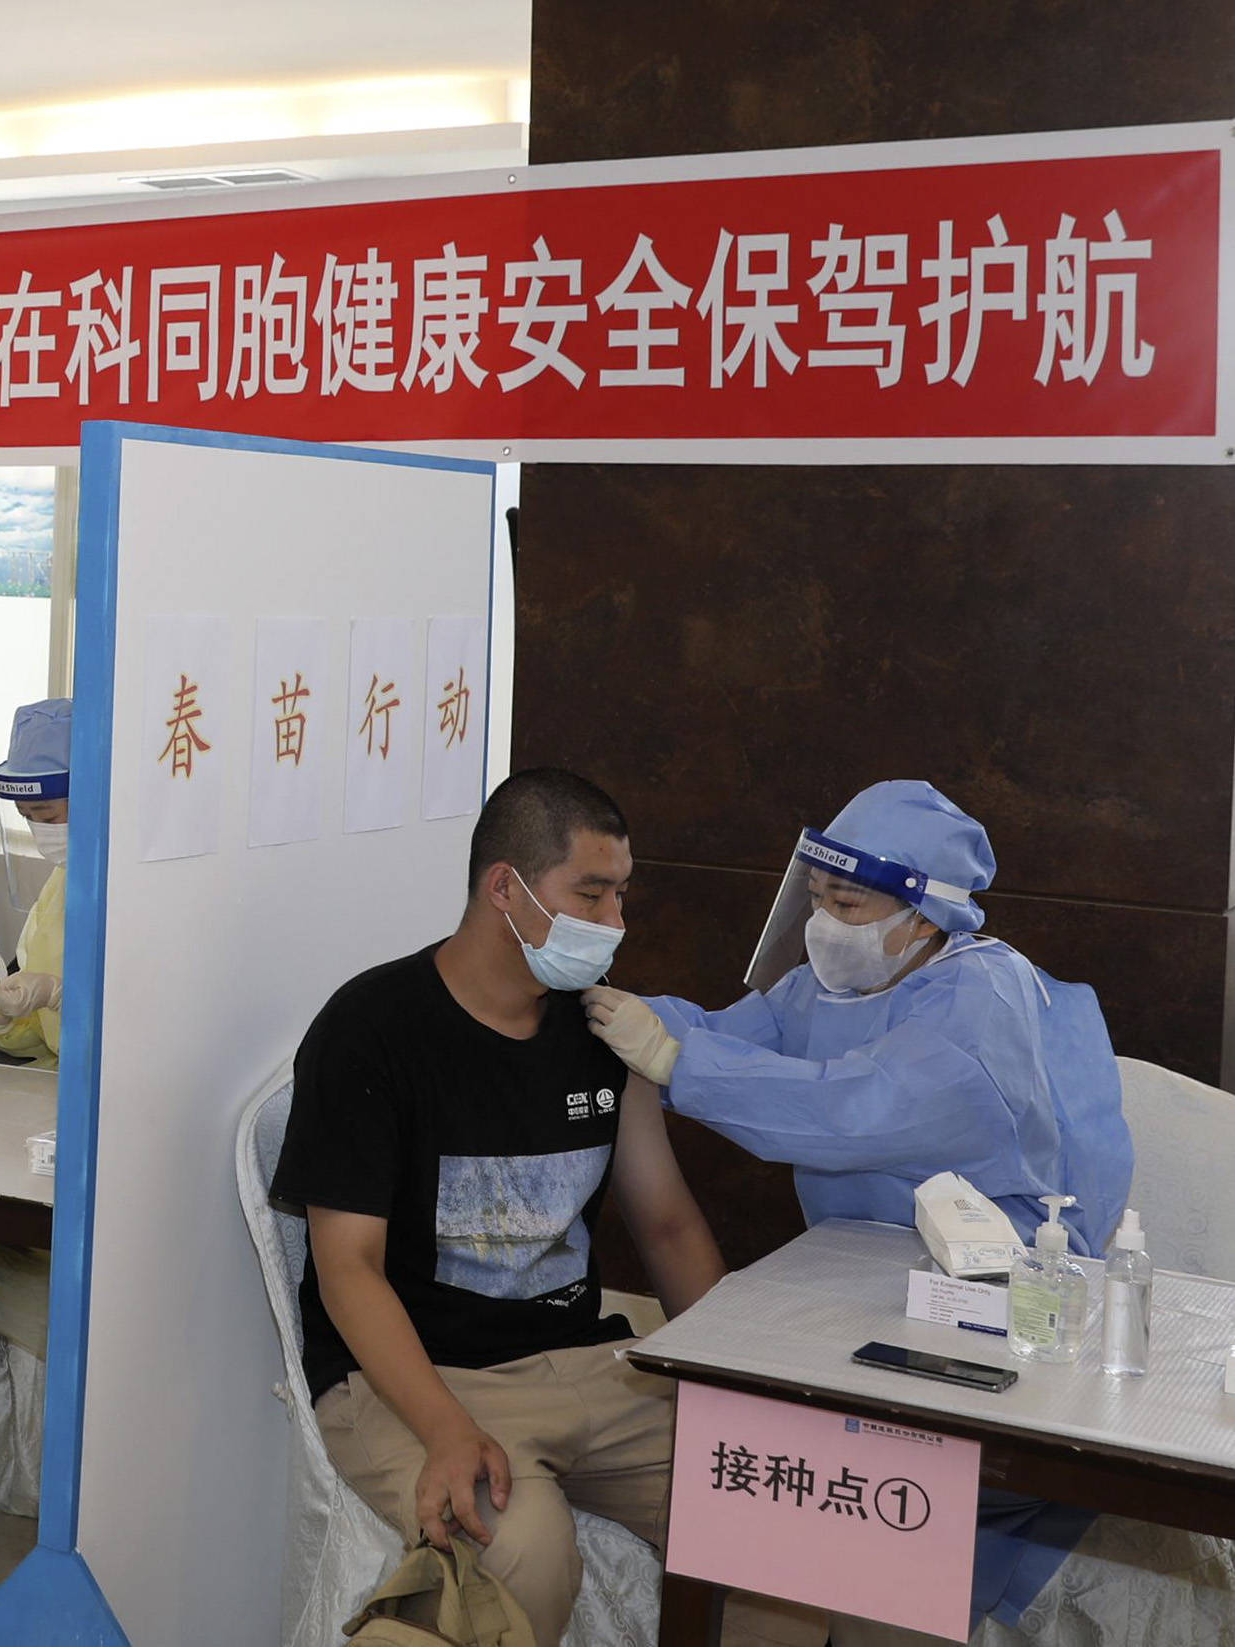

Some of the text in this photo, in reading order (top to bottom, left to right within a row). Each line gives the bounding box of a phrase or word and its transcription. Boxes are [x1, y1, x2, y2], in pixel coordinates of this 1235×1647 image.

[5, 784, 34, 793] Shield
[813, 847, 847, 866] Shield
[710, 1441, 930, 1531] 接种点①
